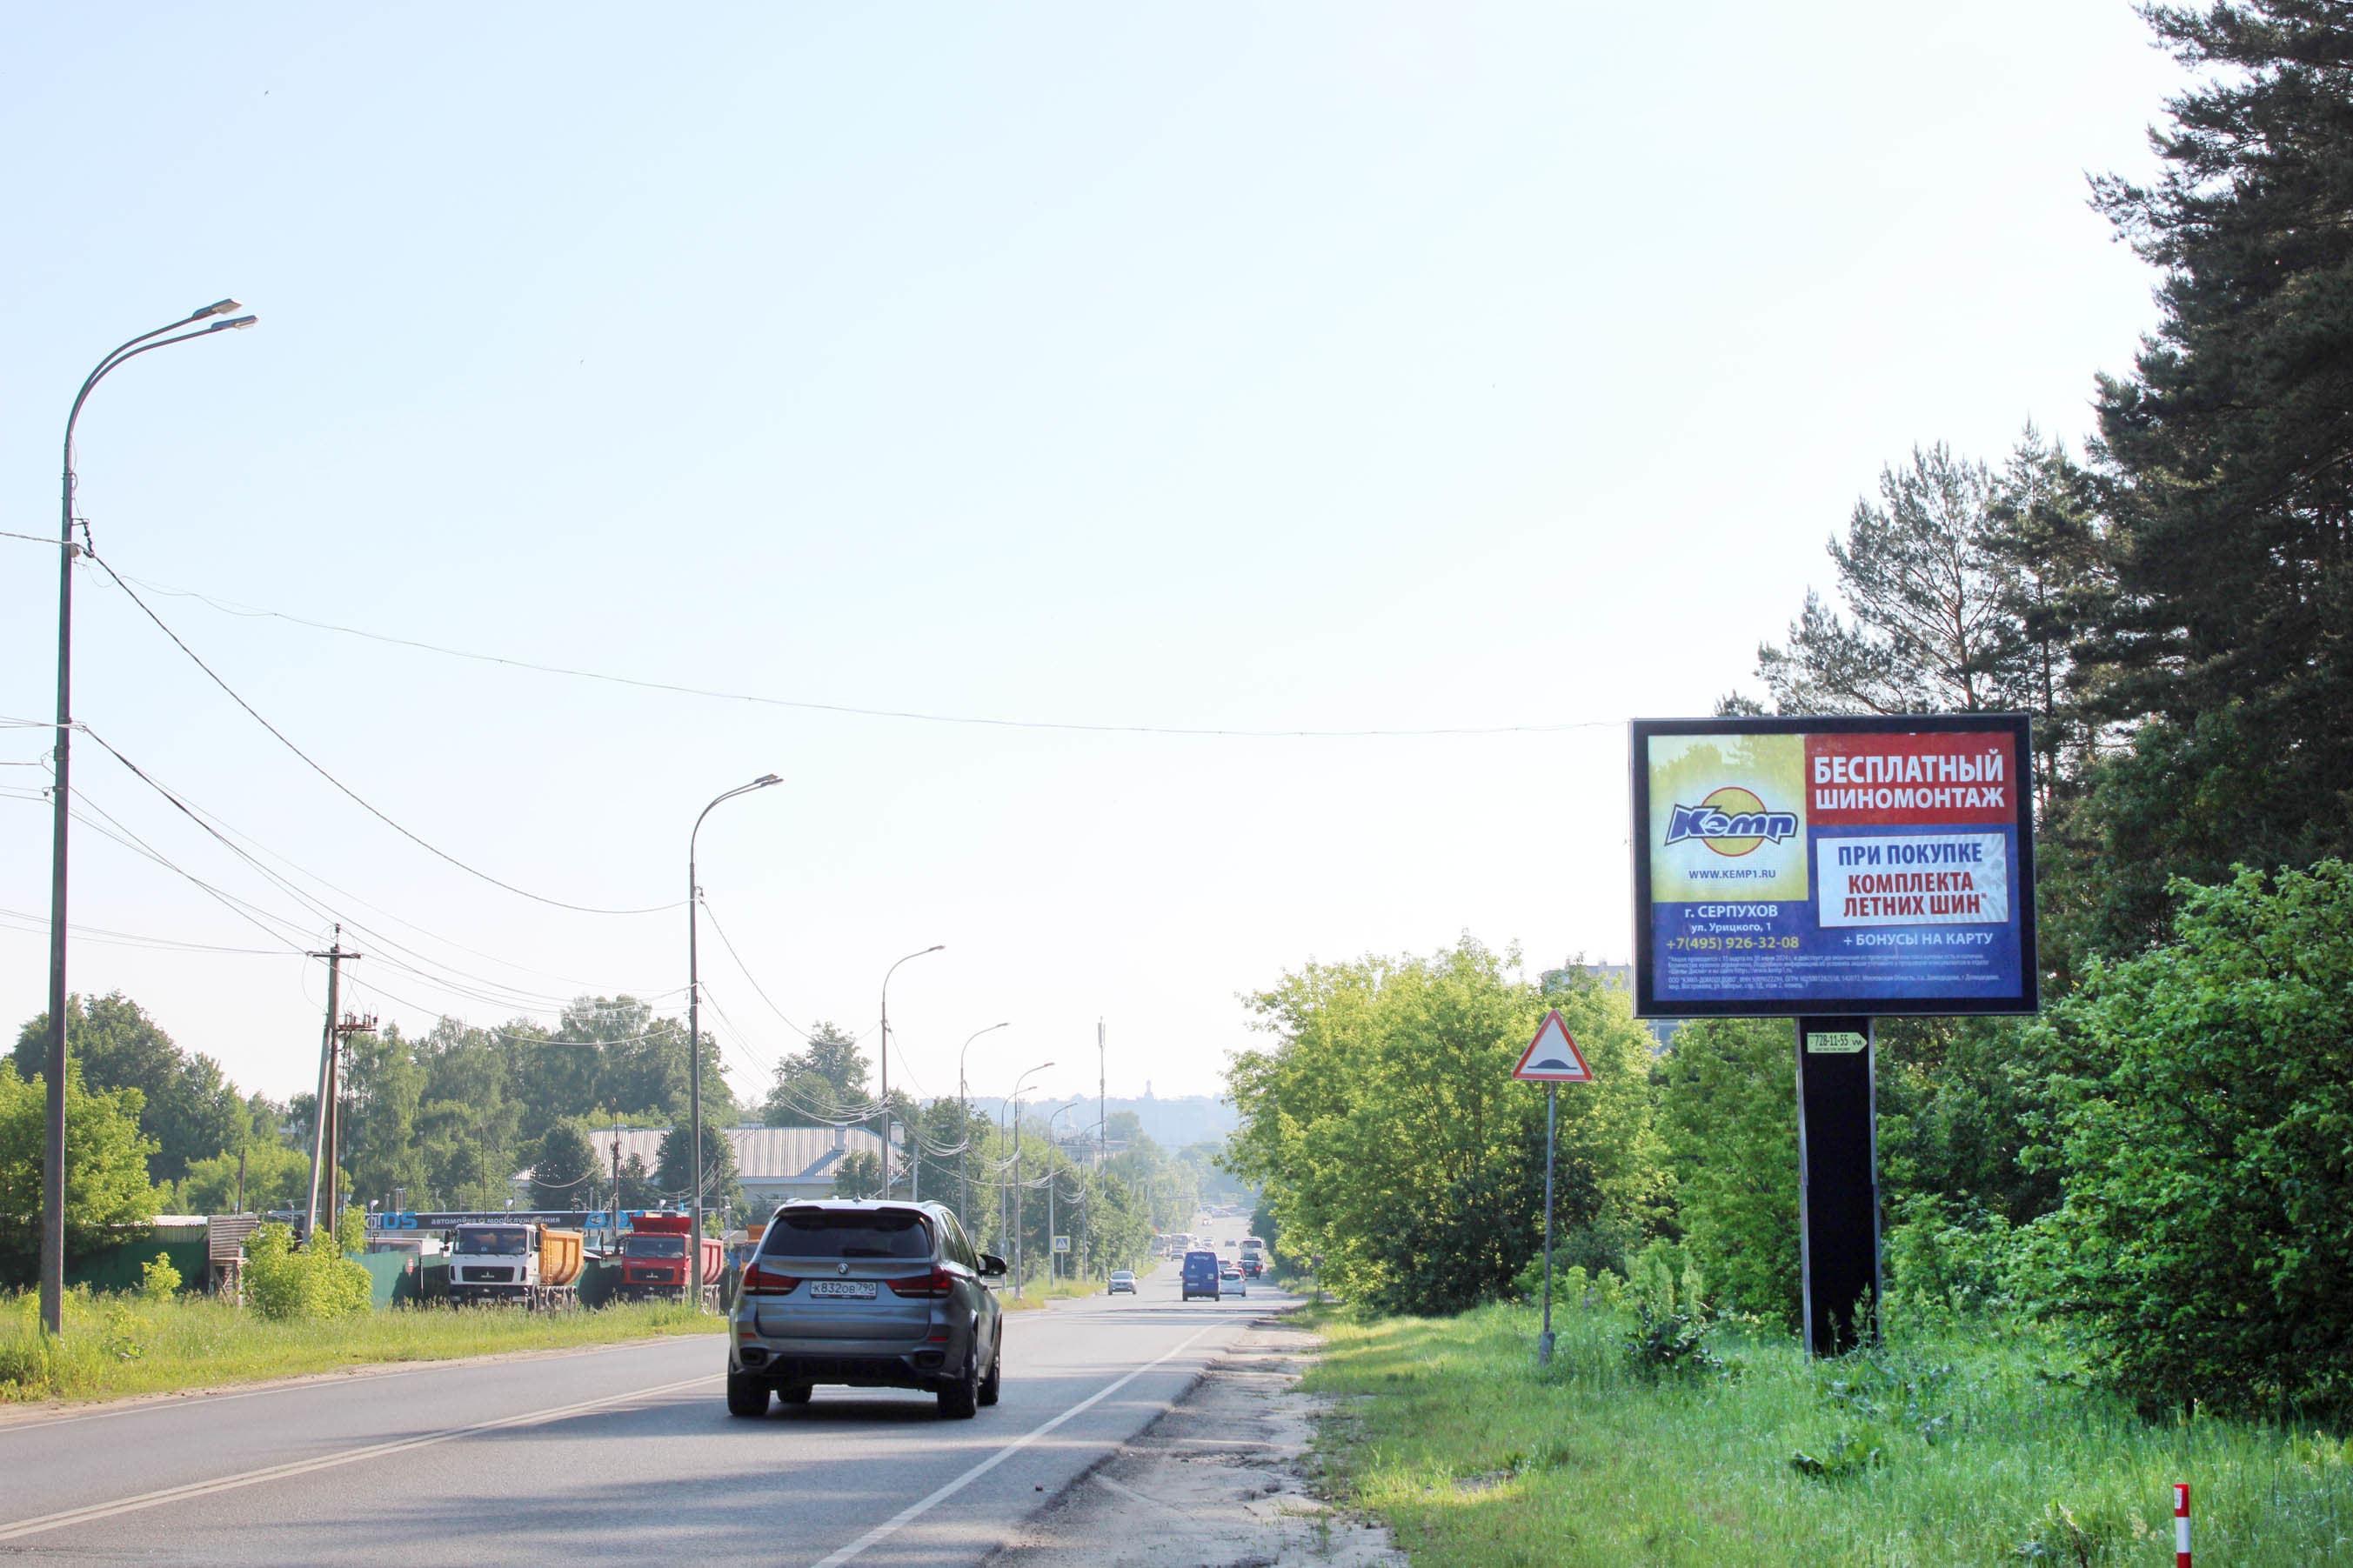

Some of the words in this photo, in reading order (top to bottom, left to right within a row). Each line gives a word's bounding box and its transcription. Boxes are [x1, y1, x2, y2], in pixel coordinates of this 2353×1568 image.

[1814, 749, 2004, 783] БЕСПЛАТНЫЙ
[1815, 787, 2005, 809] ШИНОМОНТАЖ
[1837, 845, 1881, 866] ПРИ
[1886, 842, 1982, 864] ПОКУПКЕ
[1688, 869, 1776, 879] WWW.KEMP1.RU
[1848, 871, 1975, 895] КОМПЛЕКТА
[1684, 908, 1695, 918] г.
[1697, 904, 1779, 918] СЕРПУХОВ
[1843, 896, 1926, 917] ЛЕТНИХ
[1691, 924, 1708, 935] ул.
[1708, 923, 1764, 934] Урицкого,
[1766, 922, 1772, 931] 1
[1666, 937, 1723, 951] +7(495)
[1725, 936, 1800, 950] 926-32-08
[1843, 936, 1854, 946] +
[1855, 933, 1919, 946] БОНУСЫ
[1922, 932, 1942, 945] НА
[1945, 932, 1994, 945] КАРТУ
